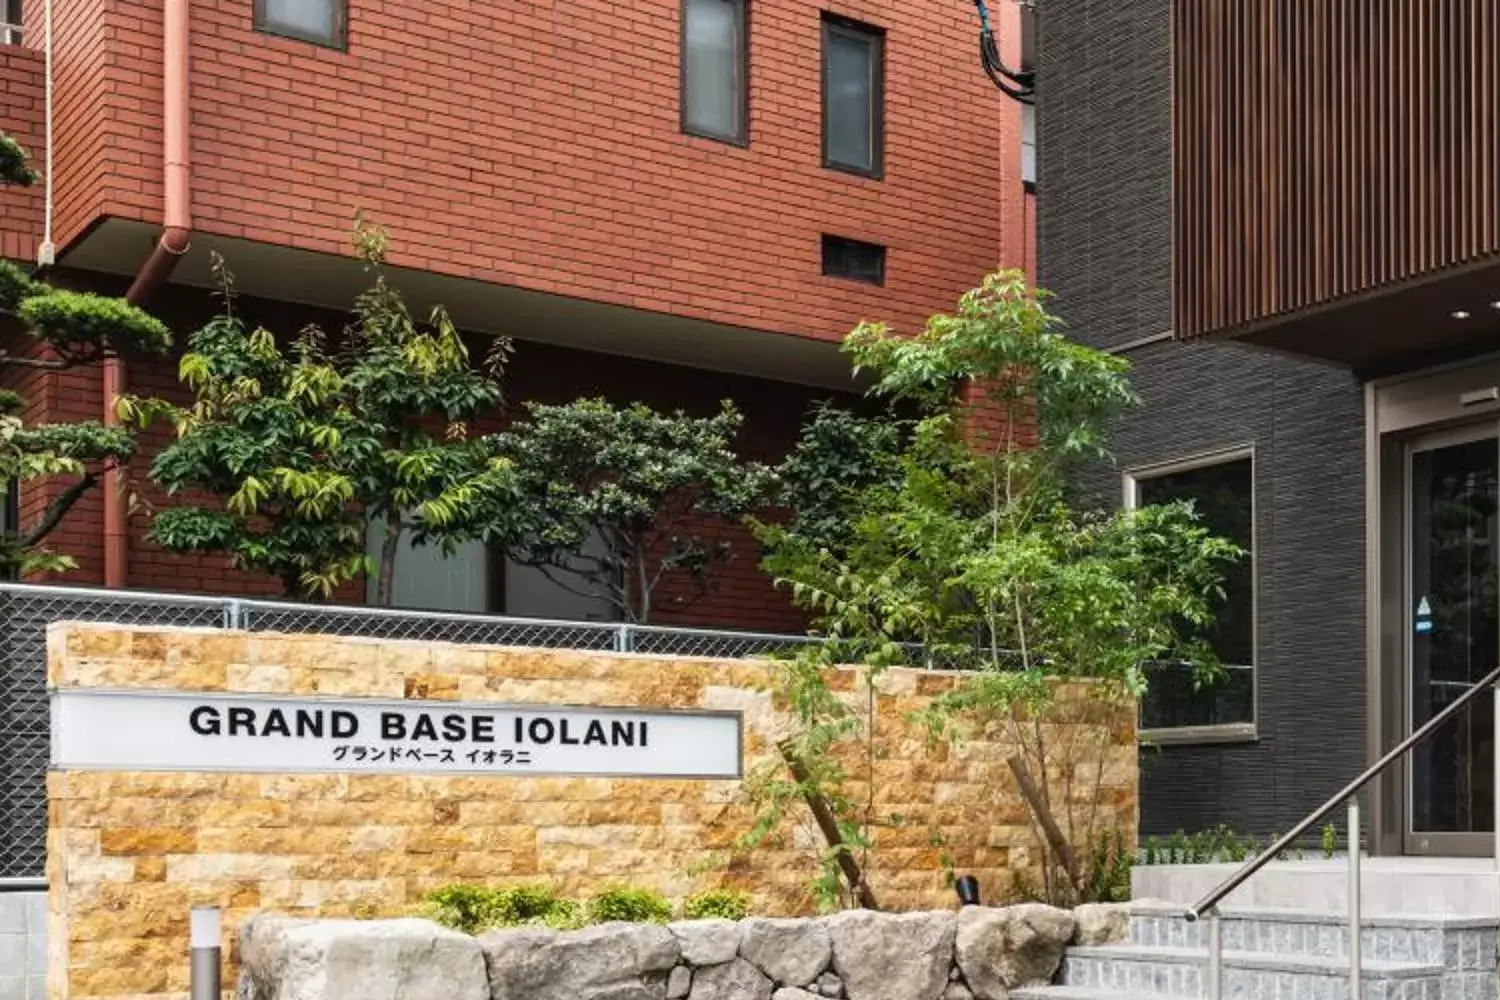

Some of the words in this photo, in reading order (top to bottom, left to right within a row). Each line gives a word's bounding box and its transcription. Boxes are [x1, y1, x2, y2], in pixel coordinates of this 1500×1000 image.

[189, 705, 358, 739] GRAND
[380, 711, 495, 743] BASE
[514, 716, 648, 747] IOLANI
[332, 745, 456, 763] グランドベース
[465, 749, 532, 765] イオラニ
